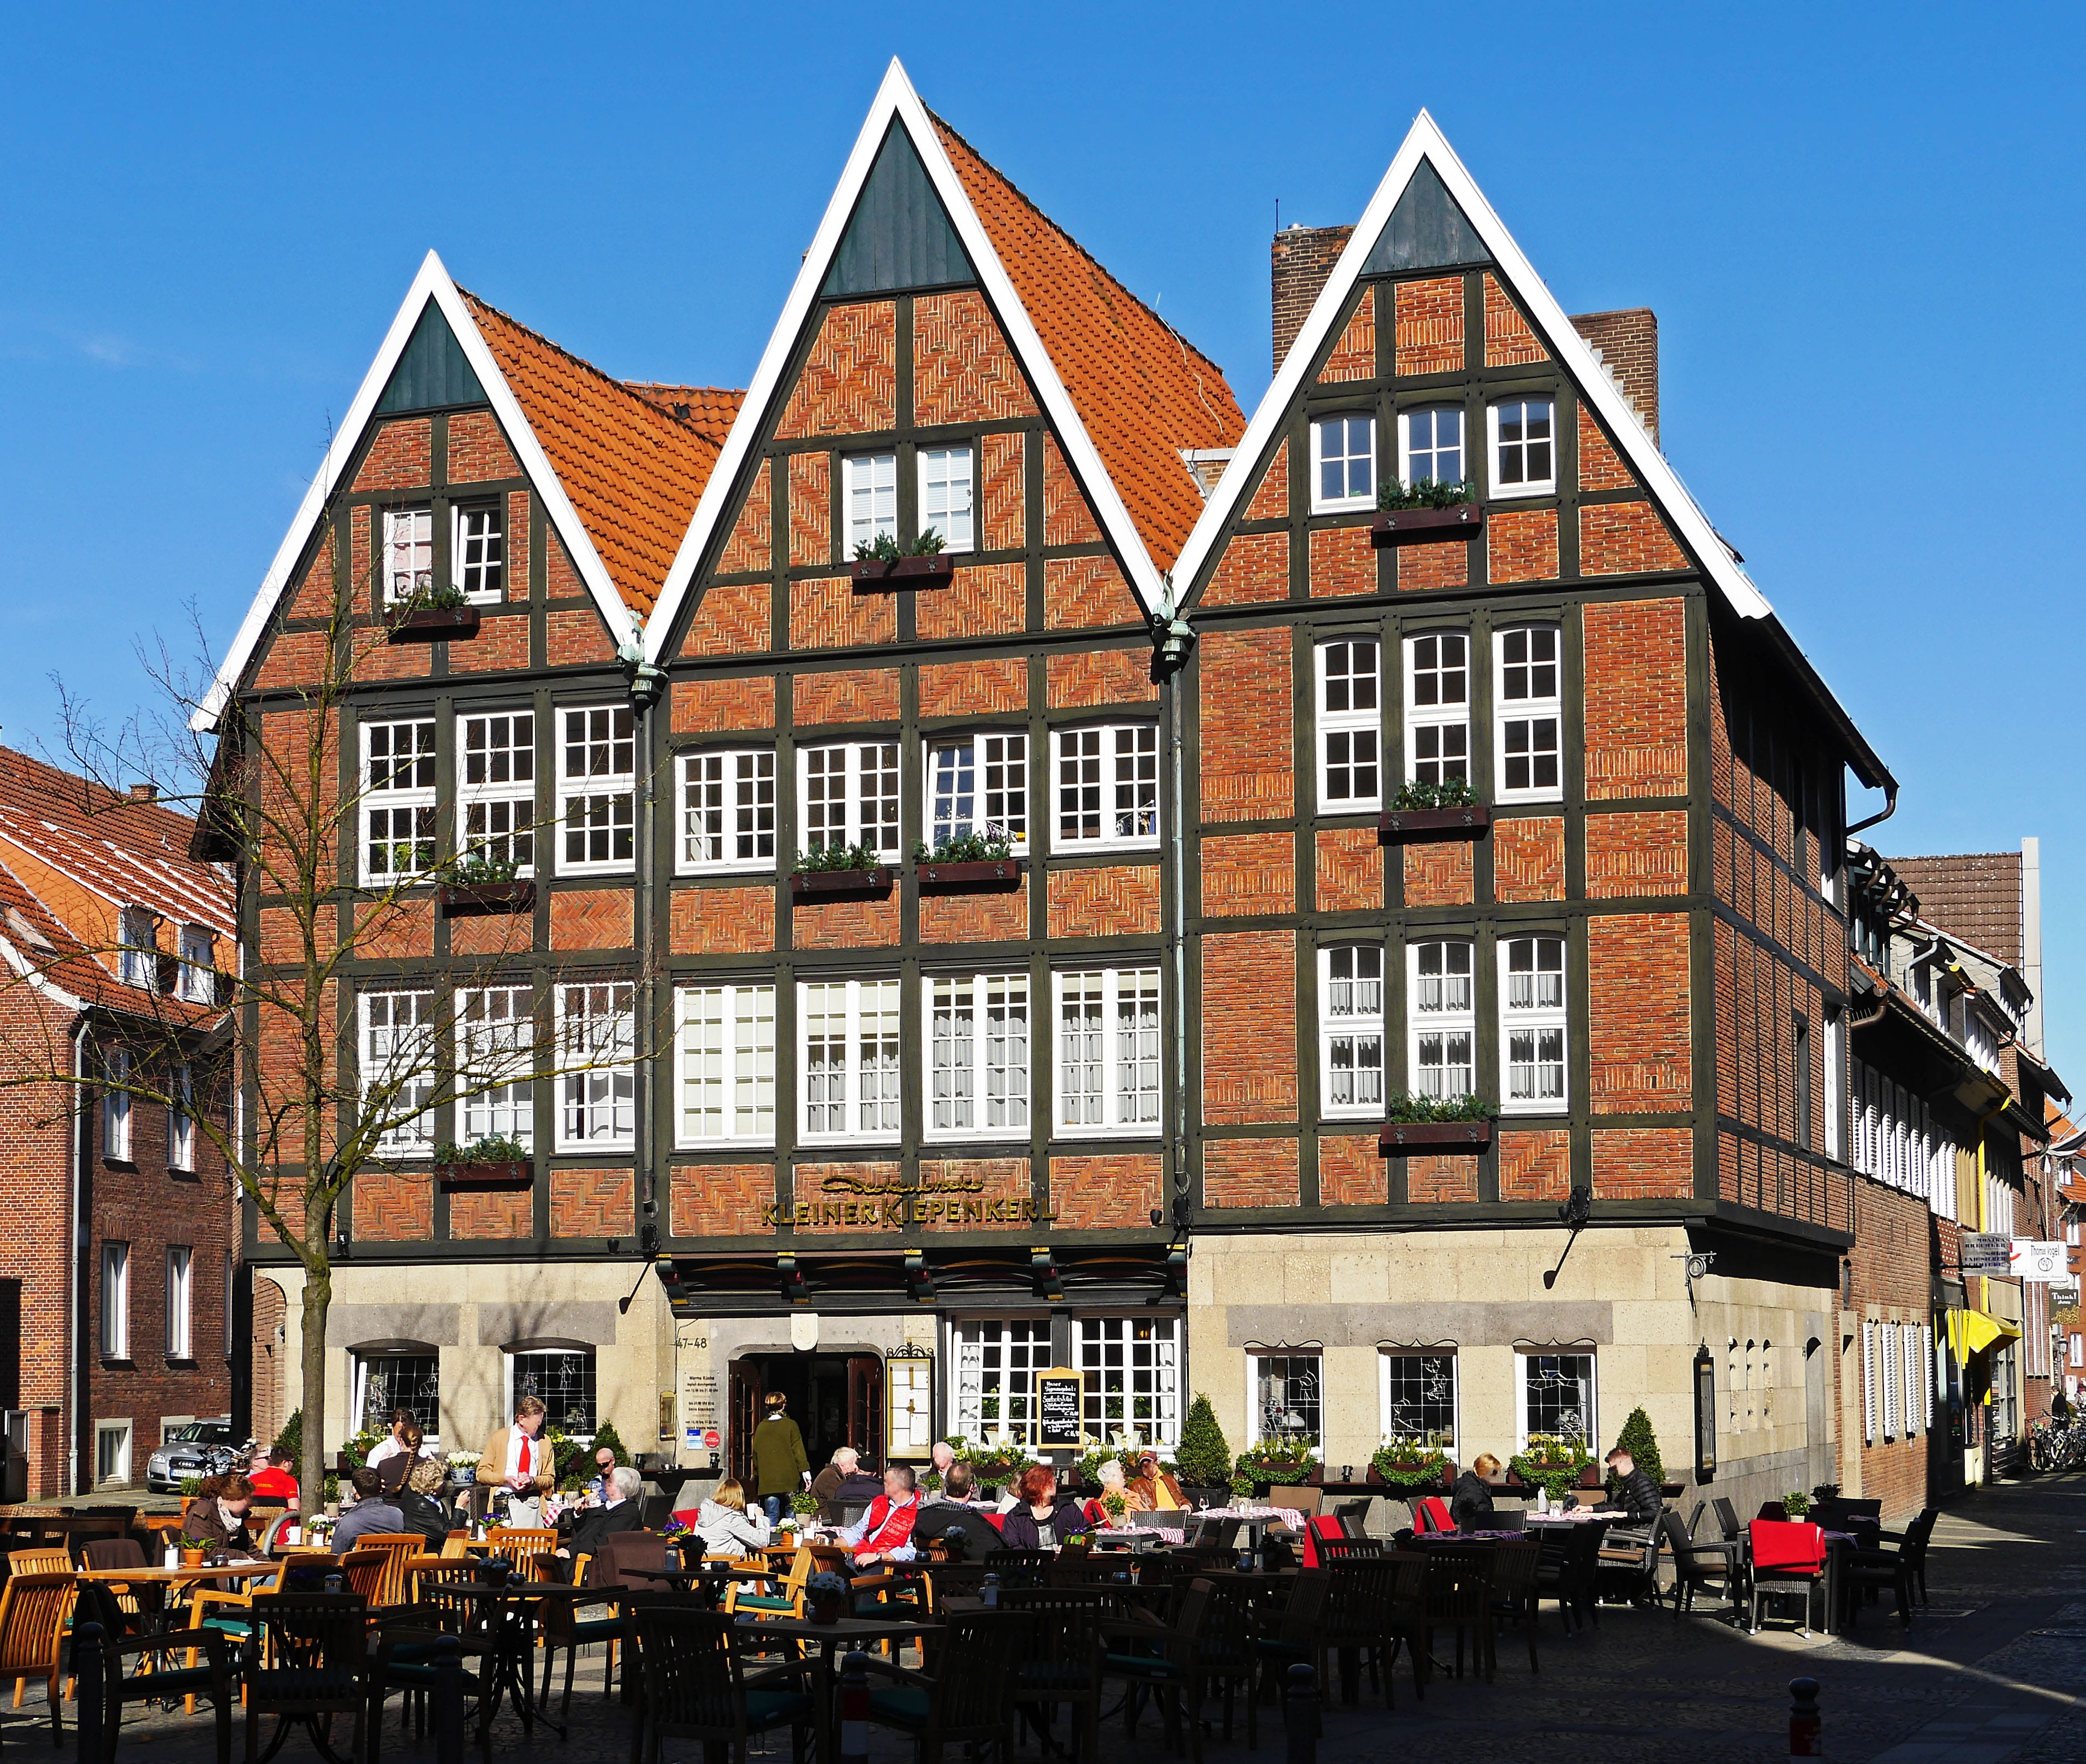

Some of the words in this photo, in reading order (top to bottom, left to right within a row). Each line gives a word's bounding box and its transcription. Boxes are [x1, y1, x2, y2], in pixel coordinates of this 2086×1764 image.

[762, 1201, 876, 1226] KLEINER
[882, 1196, 1058, 1230] KIEPENKERL
[2030, 1244, 2046, 1256] Thomas
[2047, 1244, 2060, 1258] Vogel
[2051, 1292, 2077, 1300] Think!
[676, 1338, 708, 1349] 47-48
